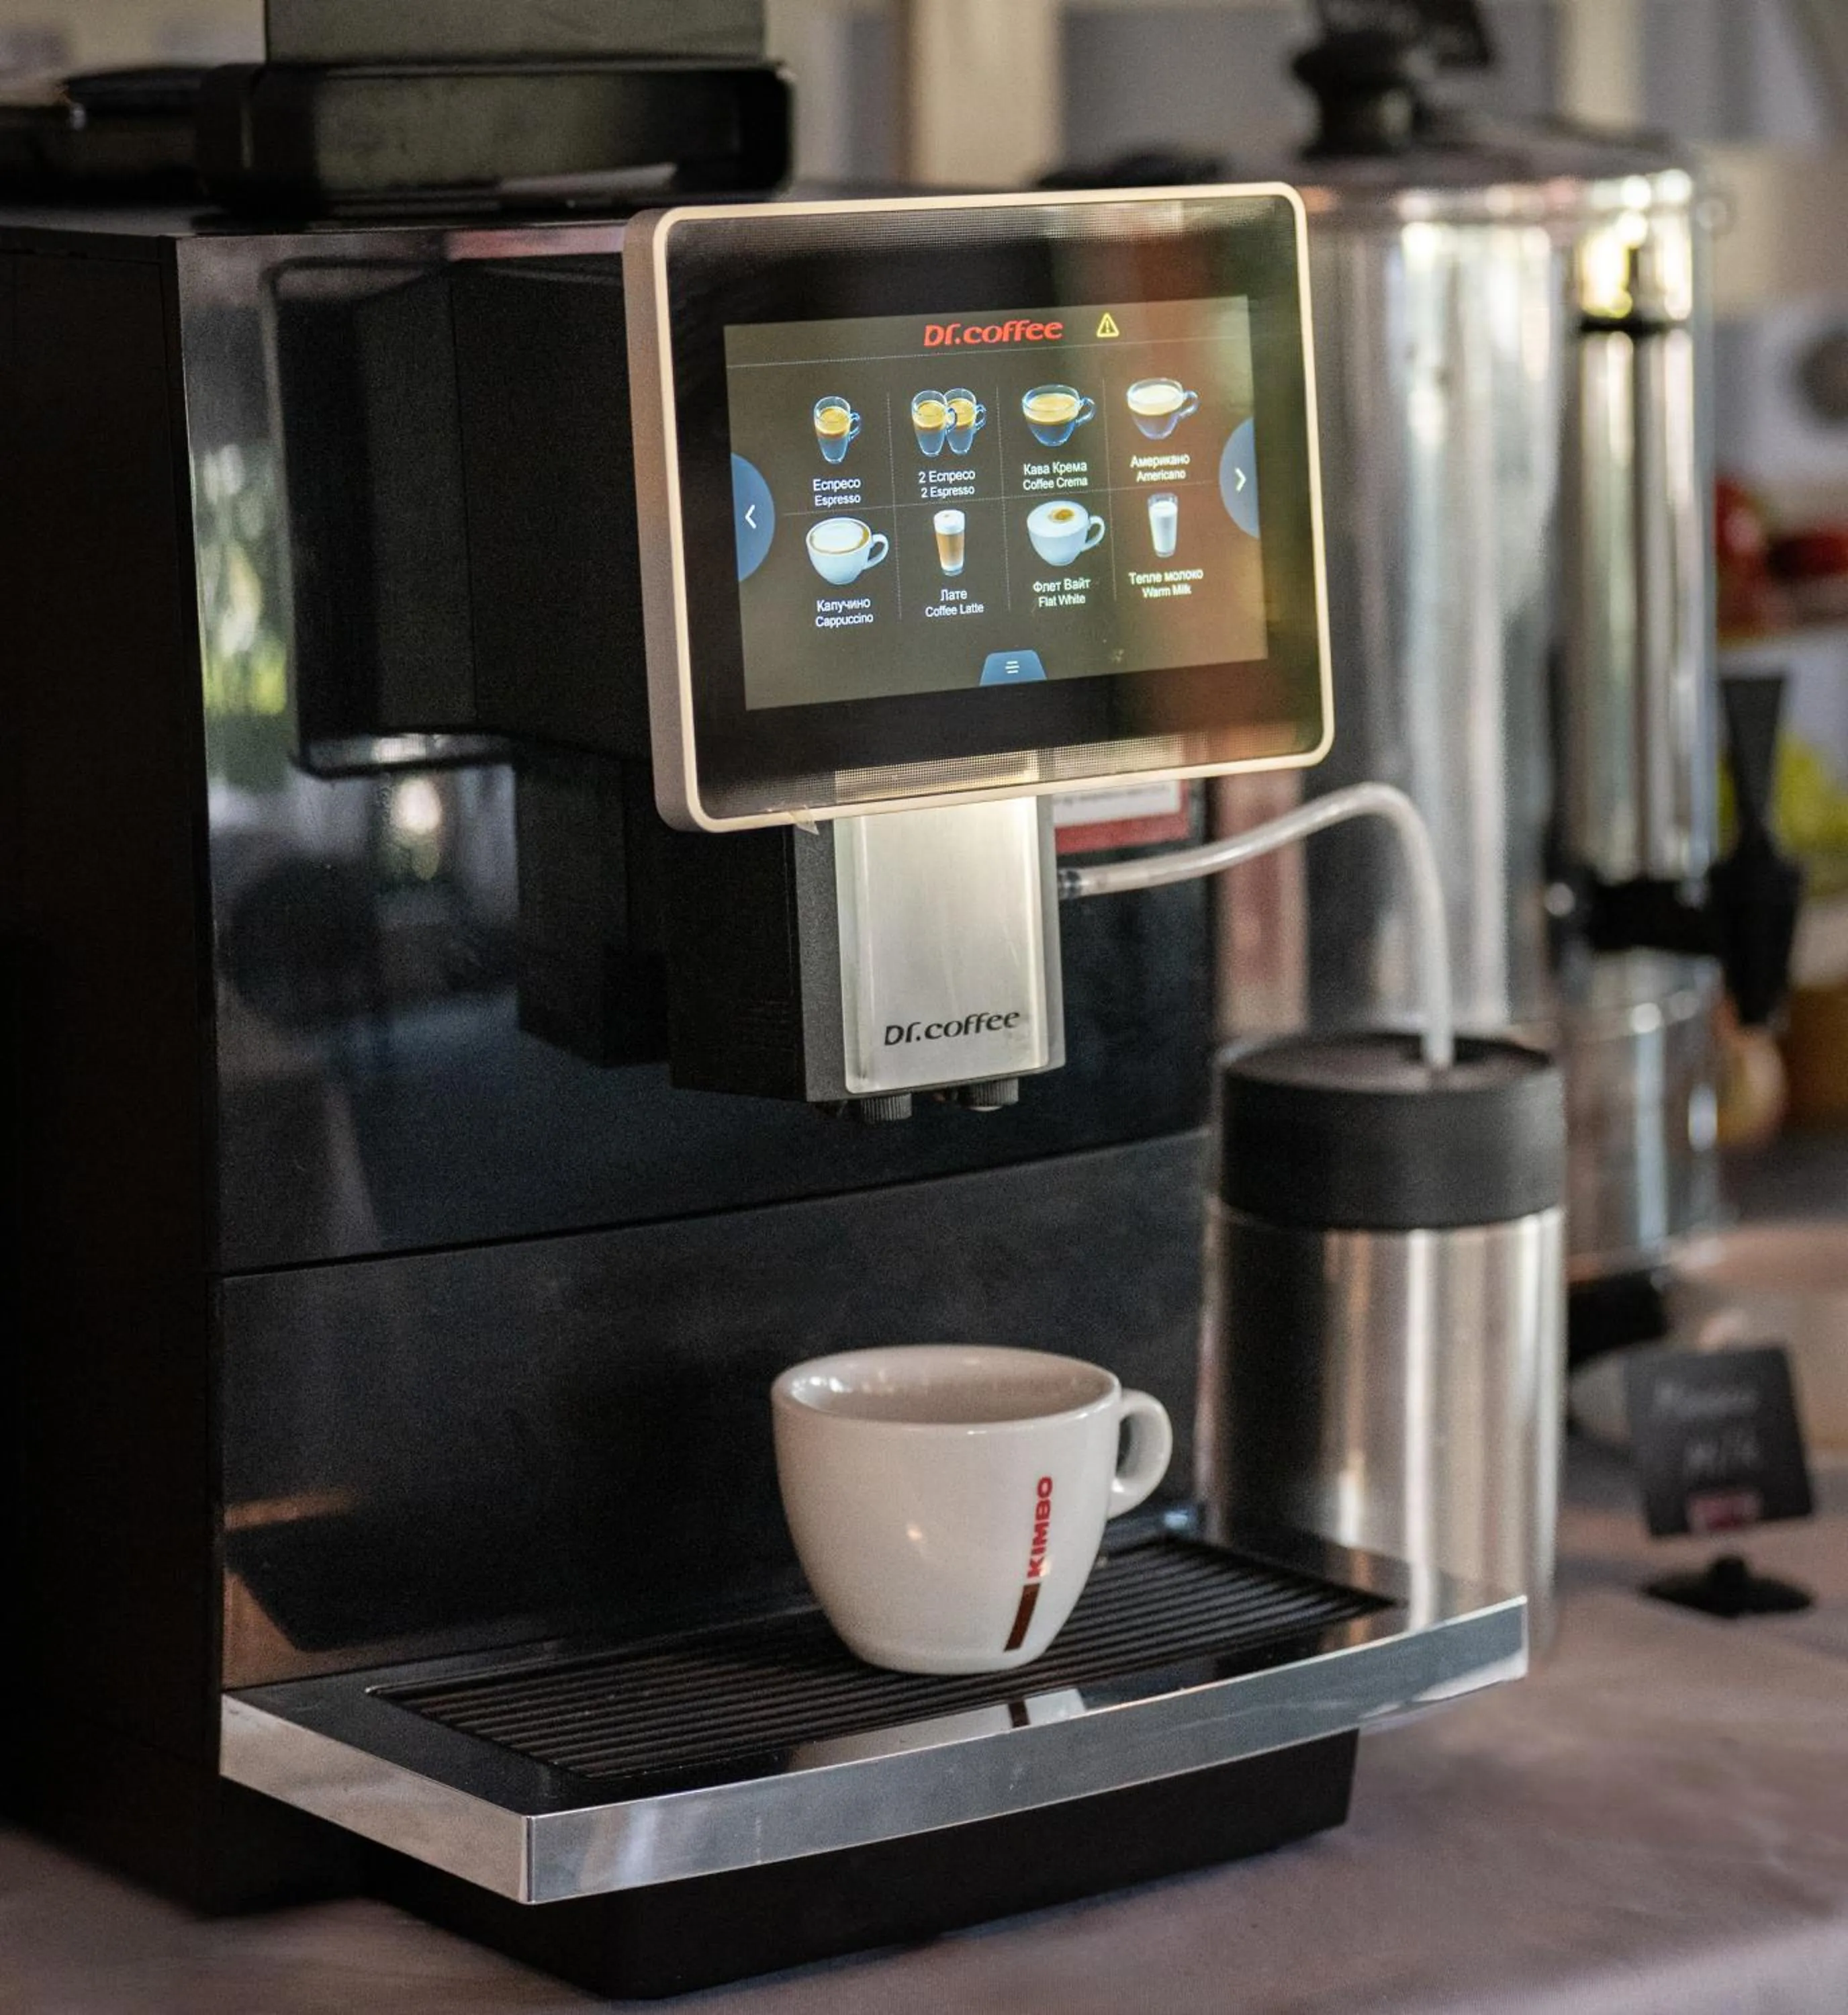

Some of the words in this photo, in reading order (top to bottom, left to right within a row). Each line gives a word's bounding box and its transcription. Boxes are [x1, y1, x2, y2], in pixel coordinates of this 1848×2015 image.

[923, 320, 1064, 347] Dr.coffee
[1023, 463, 1050, 476] Кава
[1052, 461, 1087, 476] Крема
[1129, 453, 1191, 469] Американо
[918, 472, 926, 484] 2
[929, 469, 976, 484] Еспресо
[1023, 479, 1054, 490] Coffee
[1056, 476, 1088, 488] Crema
[1136, 469, 1186, 482] Americano
[813, 478, 861, 492] Еспресо
[921, 488, 928, 498] 2
[930, 485, 975, 499] Espresso
[815, 494, 861, 508] Espresso
[1128, 572, 1162, 585] Тепле
[1164, 569, 1204, 582] молоко
[1032, 580, 1060, 594] Флет
[1064, 577, 1091, 590] Вайт
[1142, 586, 1170, 598] Warm
[1172, 584, 1192, 596] Milk
[940, 589, 968, 601] Лате
[1038, 596, 1057, 607] Flat
[1058, 594, 1086, 605] White
[817, 598, 871, 613] Капучино
[925, 606, 958, 617] Coffee
[960, 602, 984, 615] Latte
[815, 612, 874, 628] Cappuccino
[884, 1012, 1020, 1046] Dr.coffee
[1027, 1476, 1053, 1578] KIMBO
